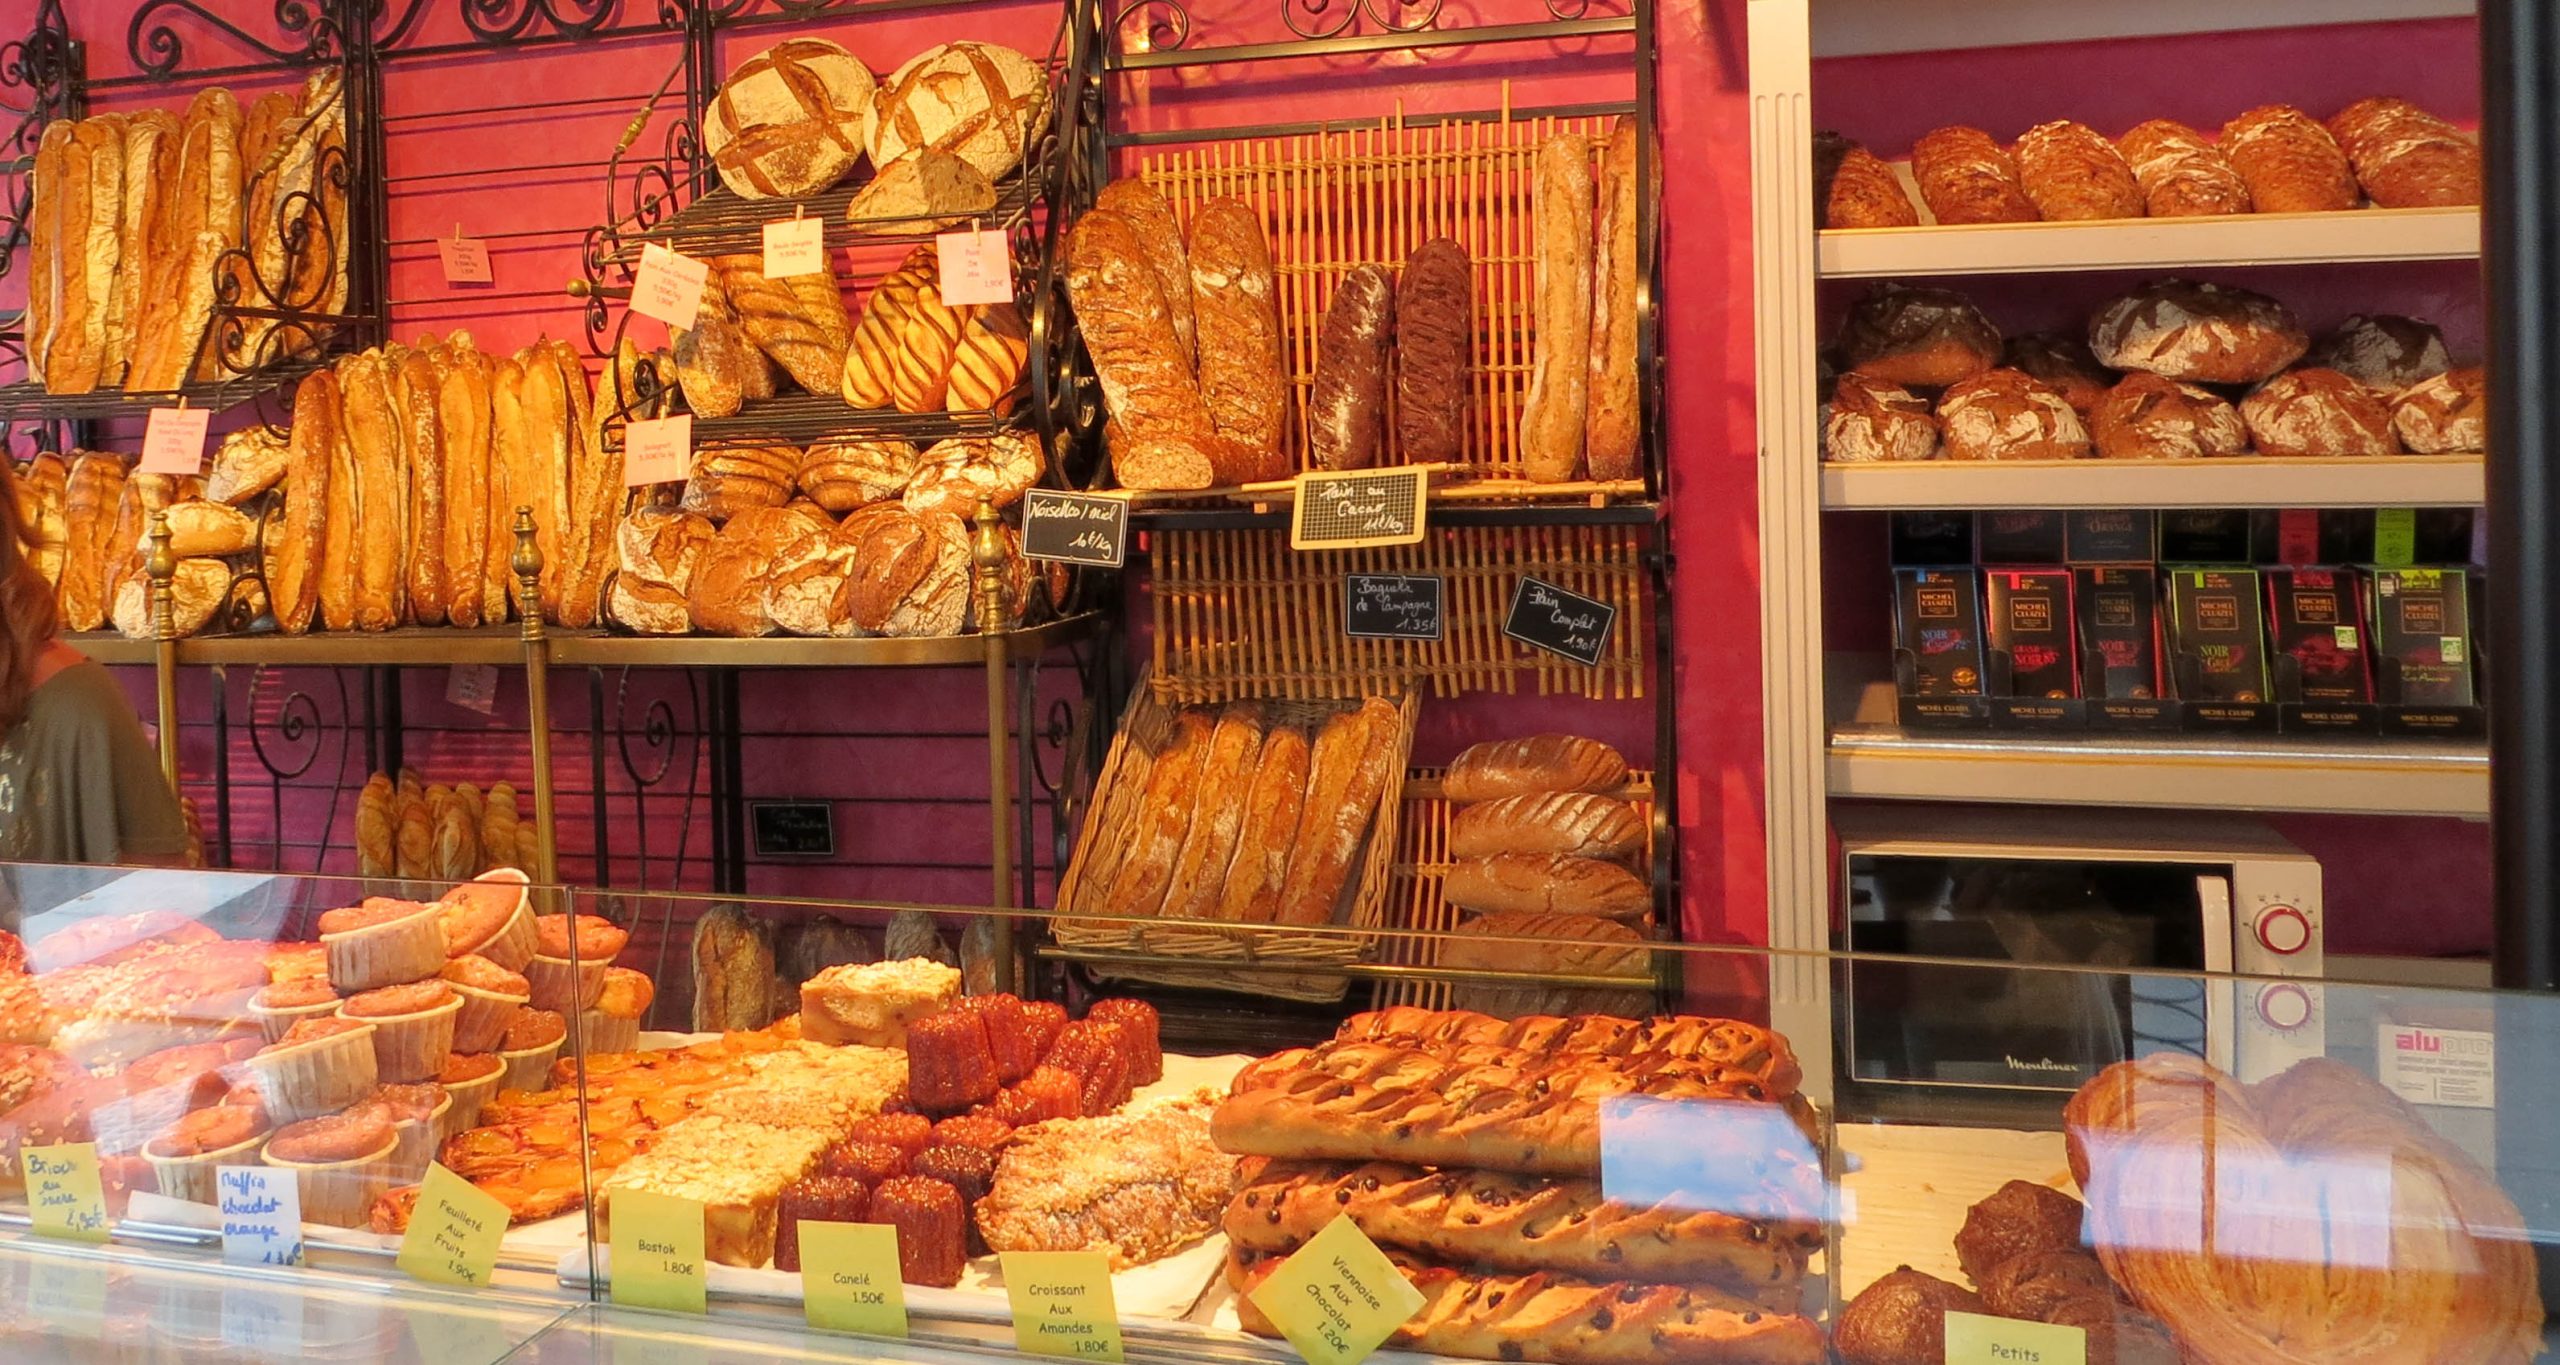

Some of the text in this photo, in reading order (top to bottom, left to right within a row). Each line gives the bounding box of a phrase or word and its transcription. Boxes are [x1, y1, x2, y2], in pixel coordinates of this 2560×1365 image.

[1320, 481, 1386, 502] Pain au
[1337, 501, 1386, 518] Cacao
[1528, 586, 1559, 609] Pain
[2015, 603, 2046, 611] MICHEL
[1550, 608, 1597, 631] Complet
[1920, 629, 1948, 640] NOIR
[2014, 653, 2042, 666] NOIR
[2200, 645, 2229, 657] NOIR
[2005, 1055, 2080, 1072] Moulinex
[439, 1199, 483, 1233] Feuilleté
[445, 1223, 467, 1241] Aux
[433, 1233, 465, 1259] Fruits
[638, 1239, 676, 1256] Bostok
[447, 1260, 476, 1283] 1.90€
[663, 1260, 694, 1275] 1.80€
[833, 1271, 870, 1286] Canelé
[1332, 1255, 1382, 1311] Viennoise
[852, 1291, 885, 1304] 1.50€
[1029, 1283, 1086, 1297] Croissant
[1329, 1283, 1353, 1307] Aux
[1049, 1303, 1073, 1315] Aux
[1306, 1283, 1352, 1332] Chocolat
[1039, 1321, 1093, 1335] Amandes
[1317, 1321, 1350, 1354] 1.20€
[1991, 1343, 2040, 1362] Petits
